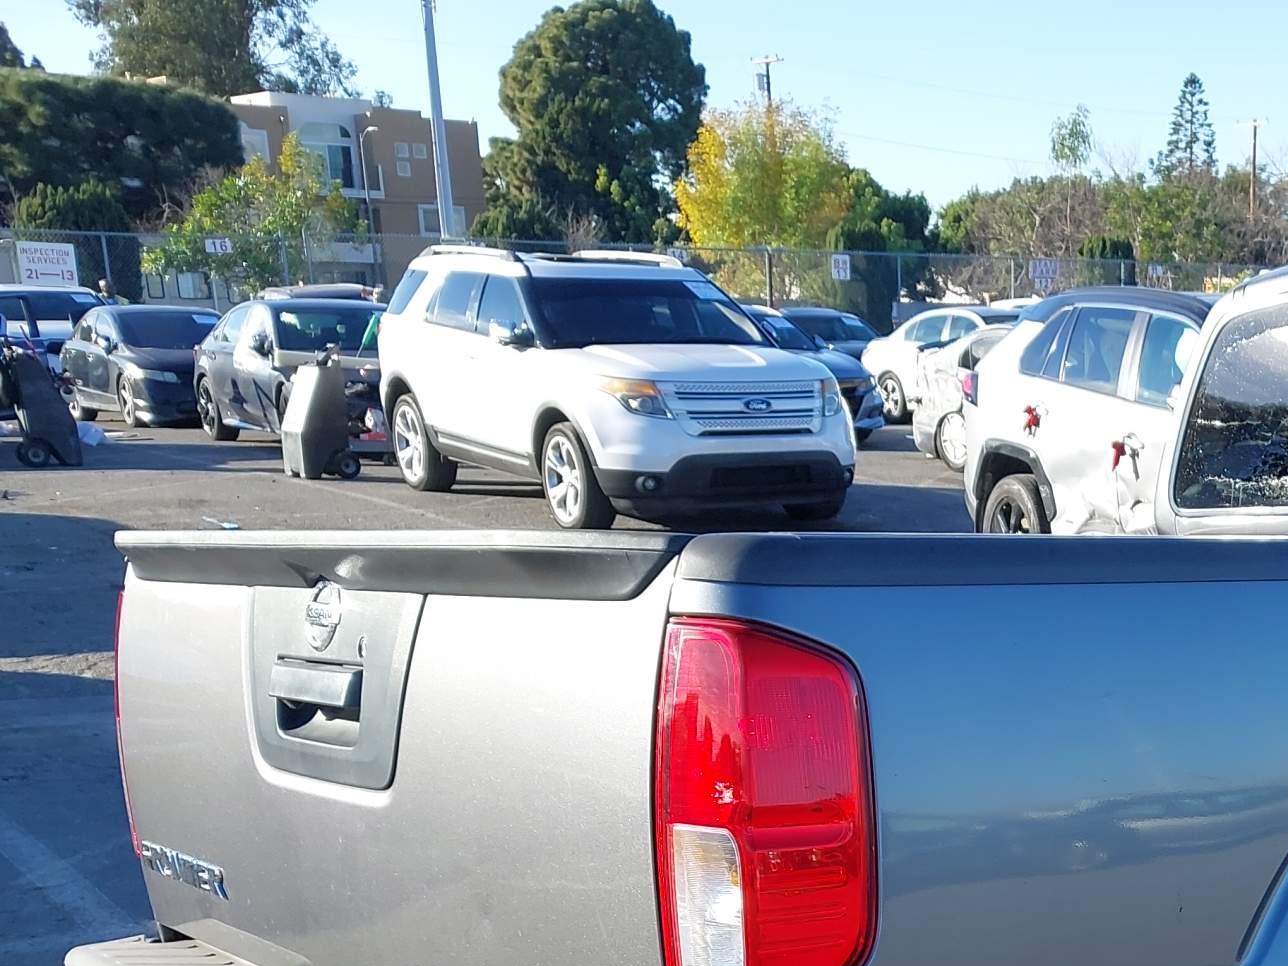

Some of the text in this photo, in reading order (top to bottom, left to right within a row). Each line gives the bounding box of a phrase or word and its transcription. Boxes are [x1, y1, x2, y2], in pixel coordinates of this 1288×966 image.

[210, 241, 228, 252] 16
[19, 247, 70, 256] INSPECTION
[26, 256, 68, 265] SERVICES
